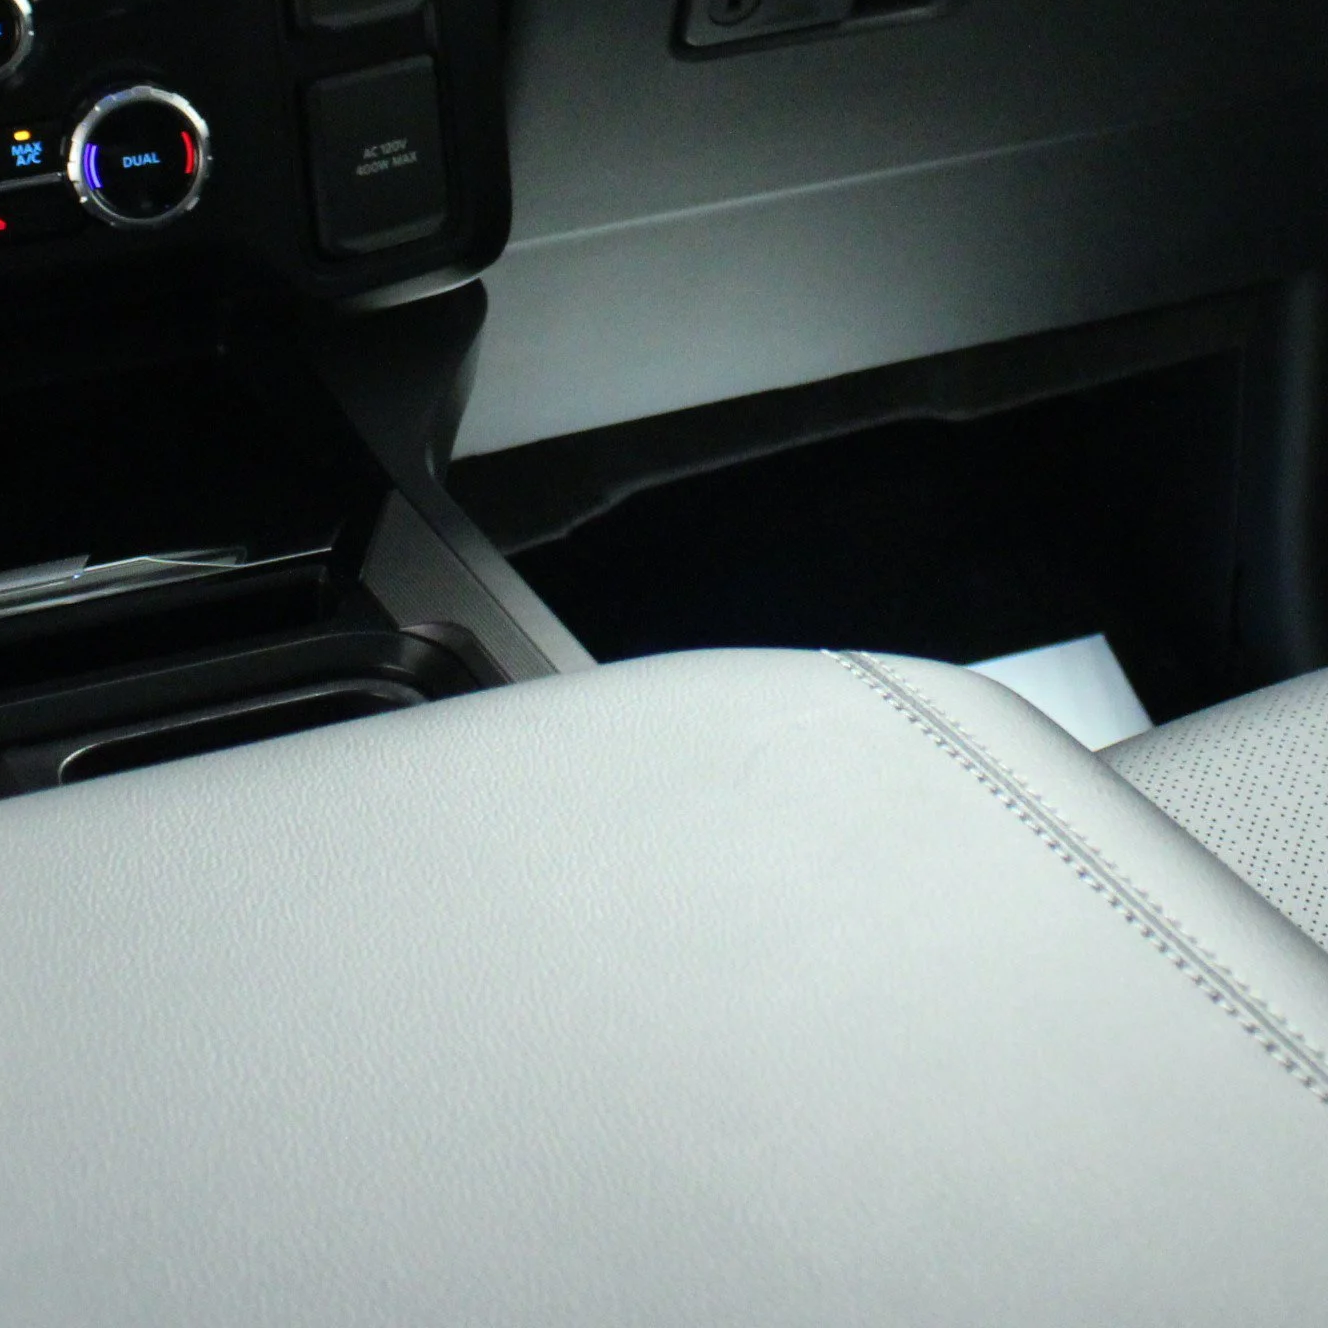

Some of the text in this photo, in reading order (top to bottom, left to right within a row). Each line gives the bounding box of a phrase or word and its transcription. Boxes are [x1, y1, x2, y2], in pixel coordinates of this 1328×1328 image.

[11, 141, 42, 156] MAX
[16, 152, 41, 166] A/C
[123, 153, 160, 169] DUAL
